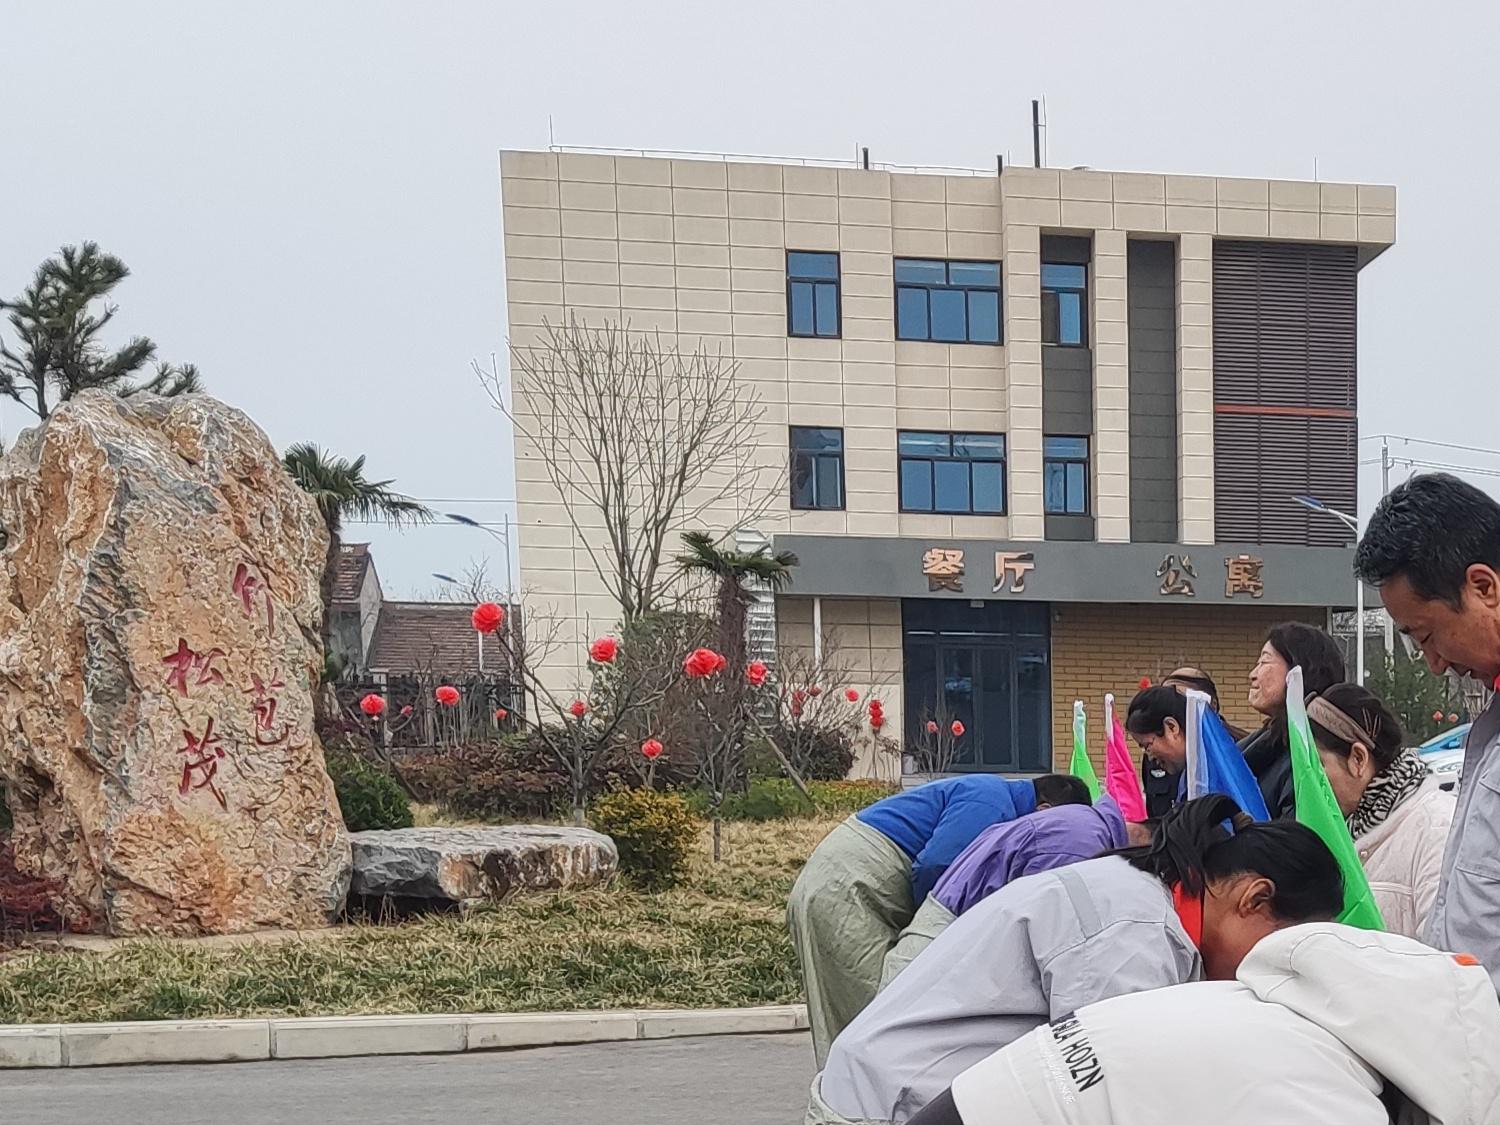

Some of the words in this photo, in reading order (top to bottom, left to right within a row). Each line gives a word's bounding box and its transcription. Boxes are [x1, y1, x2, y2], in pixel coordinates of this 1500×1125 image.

[922, 548, 1035, 593] 餐厅
[1155, 554, 1265, 598] 公寓
[161, 636, 229, 812] 松茂
[1060, 1036, 1105, 1092] HOIZN
